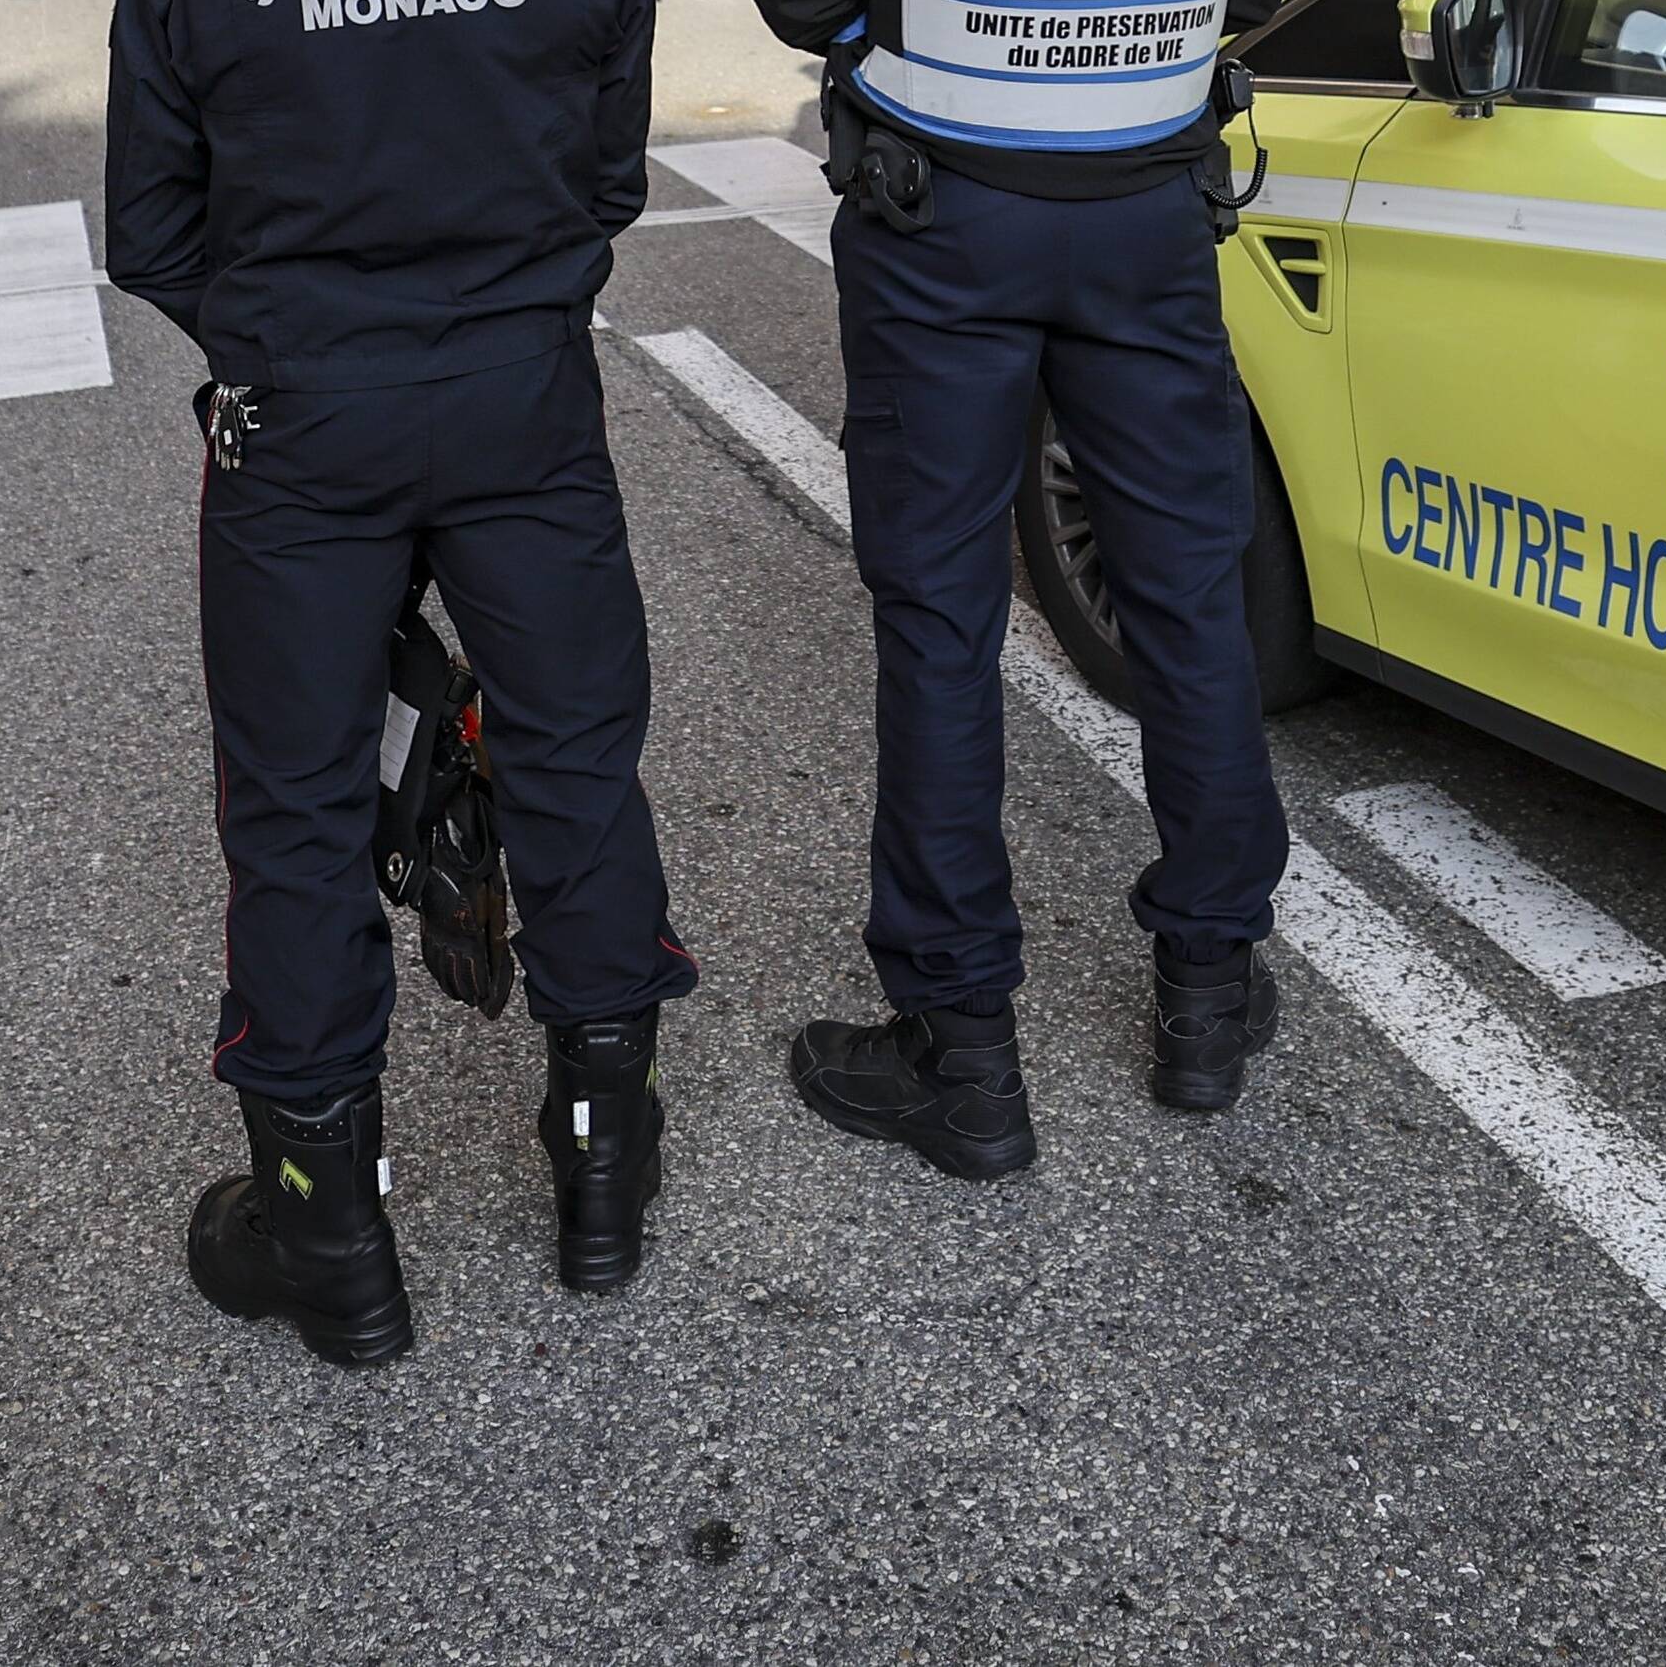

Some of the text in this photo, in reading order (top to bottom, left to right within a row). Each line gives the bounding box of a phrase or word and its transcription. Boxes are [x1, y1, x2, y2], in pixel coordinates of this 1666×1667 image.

[965, 2, 1217, 39] UNITE de PRESERVATION
[1007, 37, 1185, 69] du CADRE de VIE
[1381, 457, 1585, 618] CENTRE
